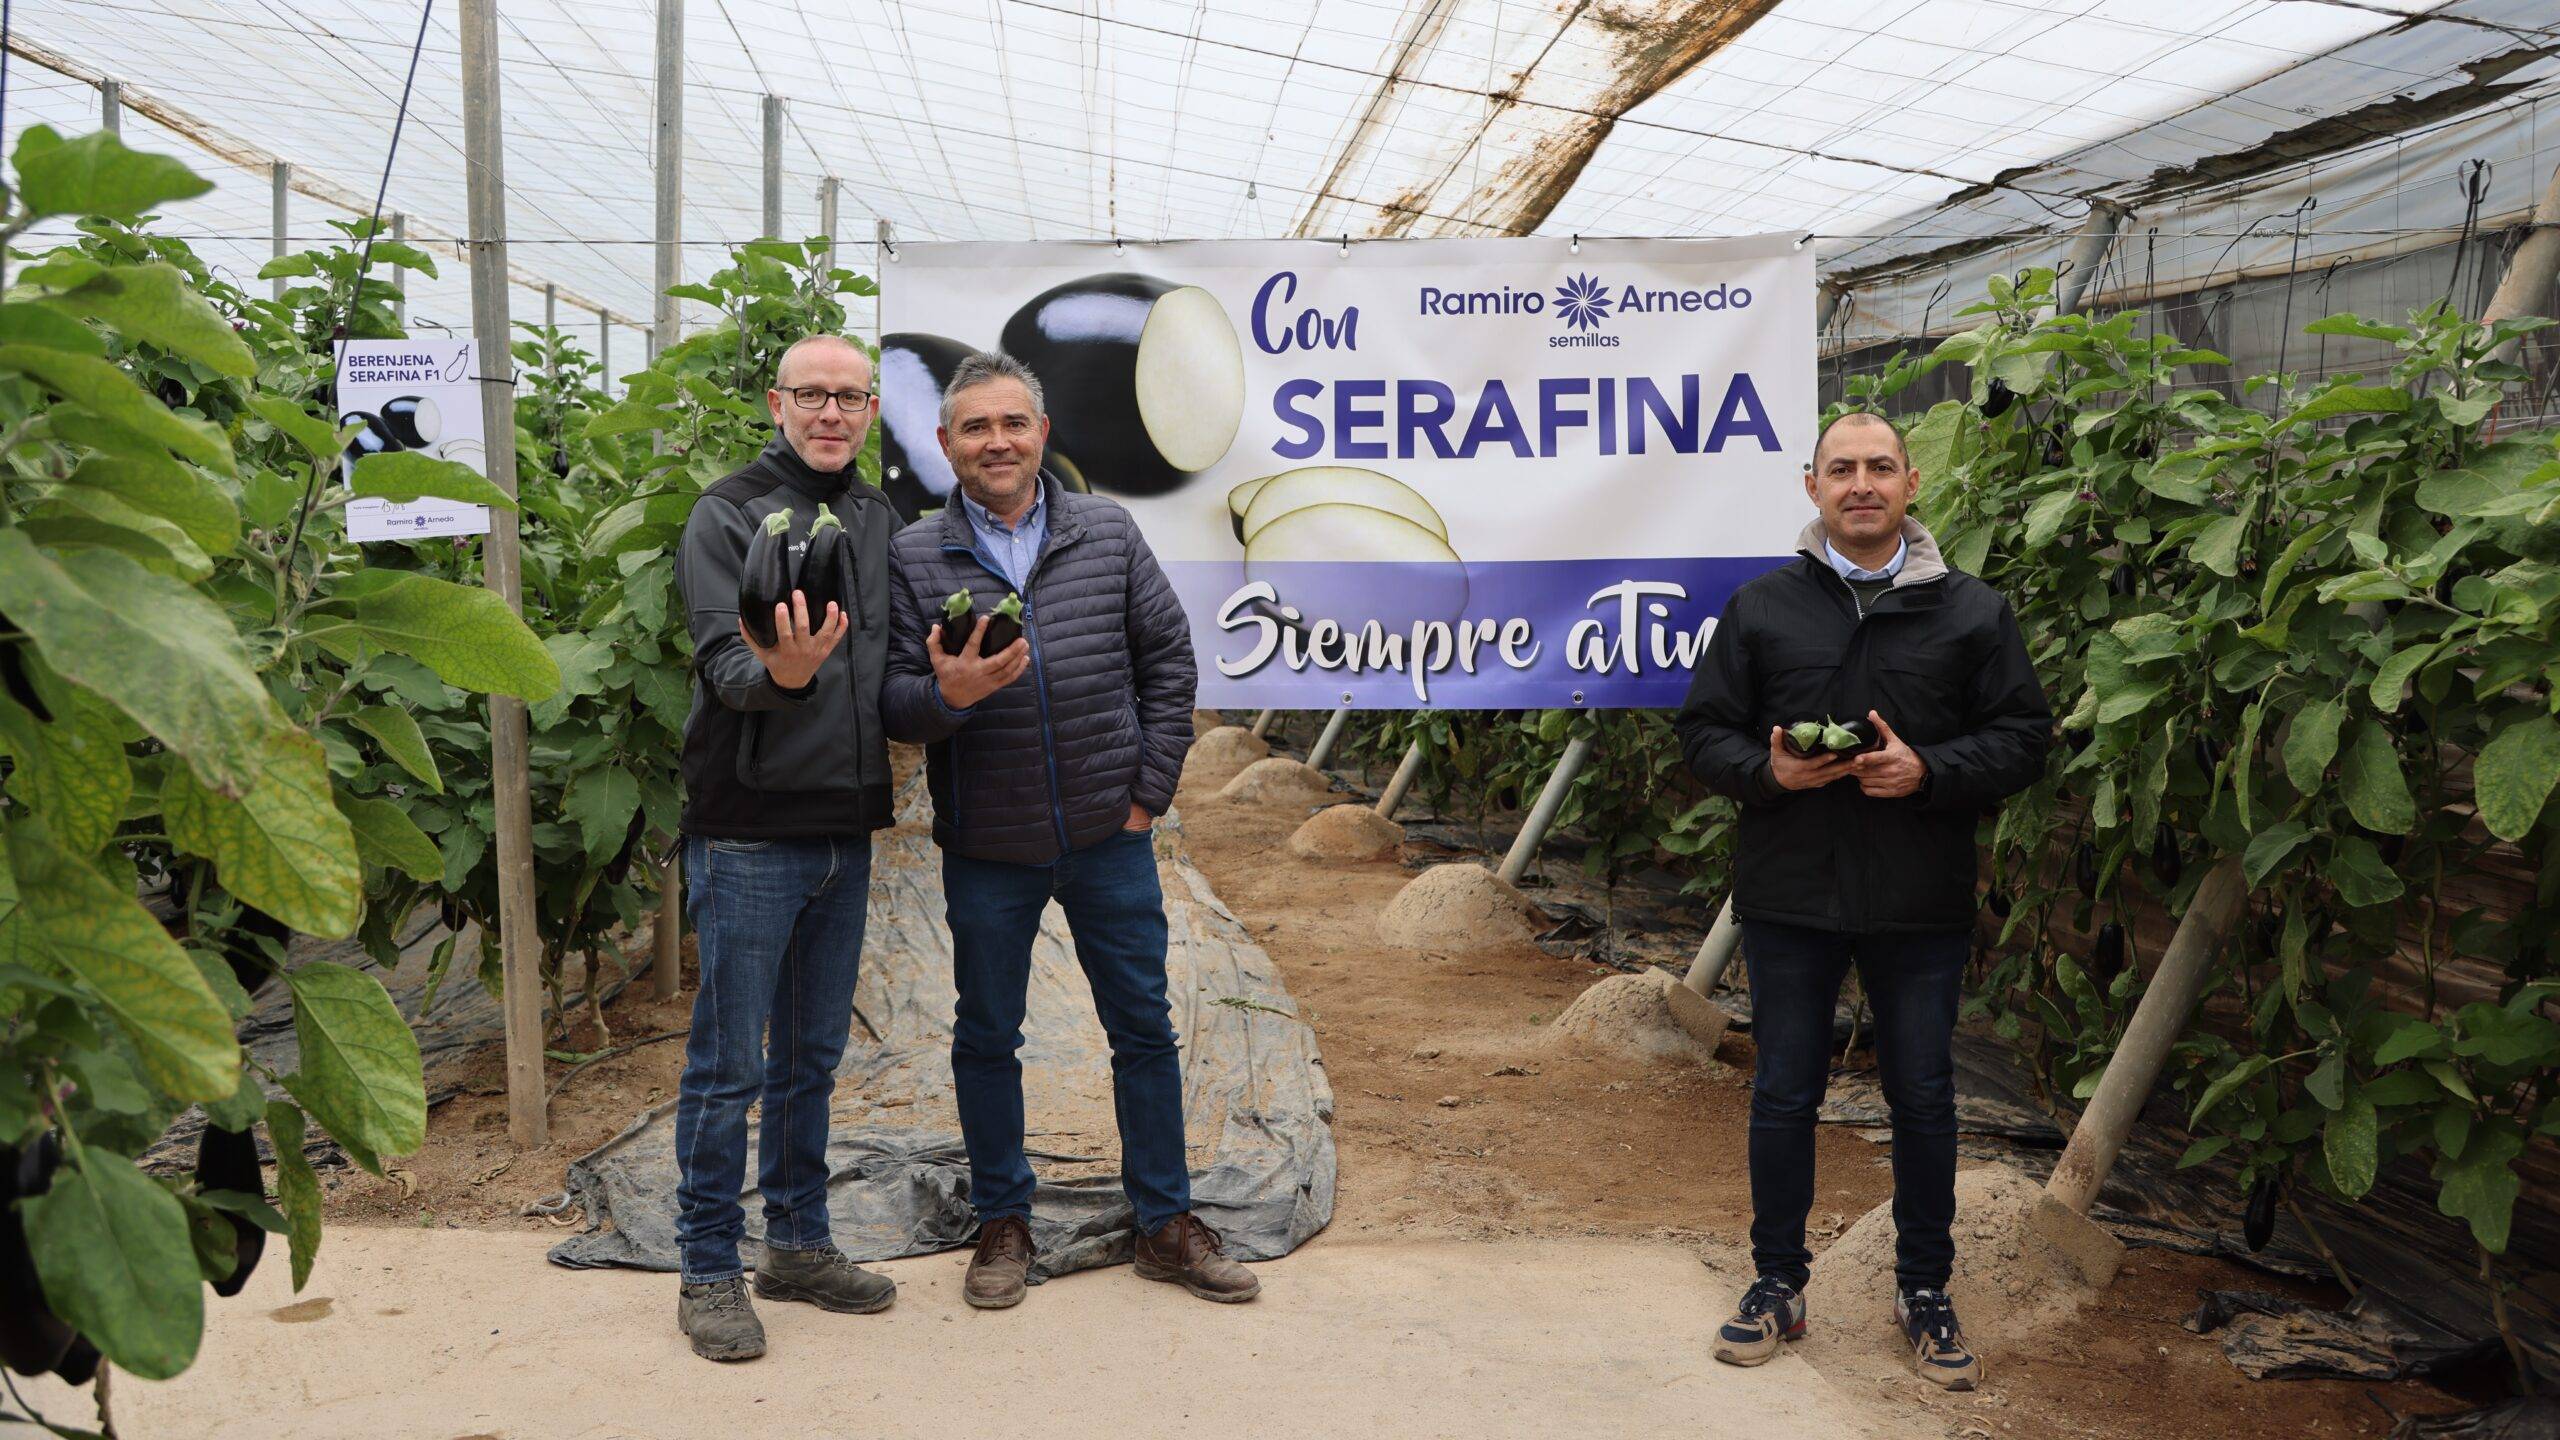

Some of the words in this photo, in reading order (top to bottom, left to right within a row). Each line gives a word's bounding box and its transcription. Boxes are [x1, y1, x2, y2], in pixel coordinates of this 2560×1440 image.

[1419, 287, 1545, 315] Ramiro
[1618, 282, 1753, 315] Arnedo
[1250, 271, 1359, 355] Con
[1549, 332, 1620, 349] semillas
[348, 355, 434, 367] BERENJENA
[349, 370, 420, 382] SERAFINA
[425, 369, 440, 380] F1
[1271, 372, 1783, 460] SERAFINA
[427, 515, 454, 523] Arnedo
[1215, 580, 1541, 702] Siempre
[1565, 579, 1719, 675] aTin
